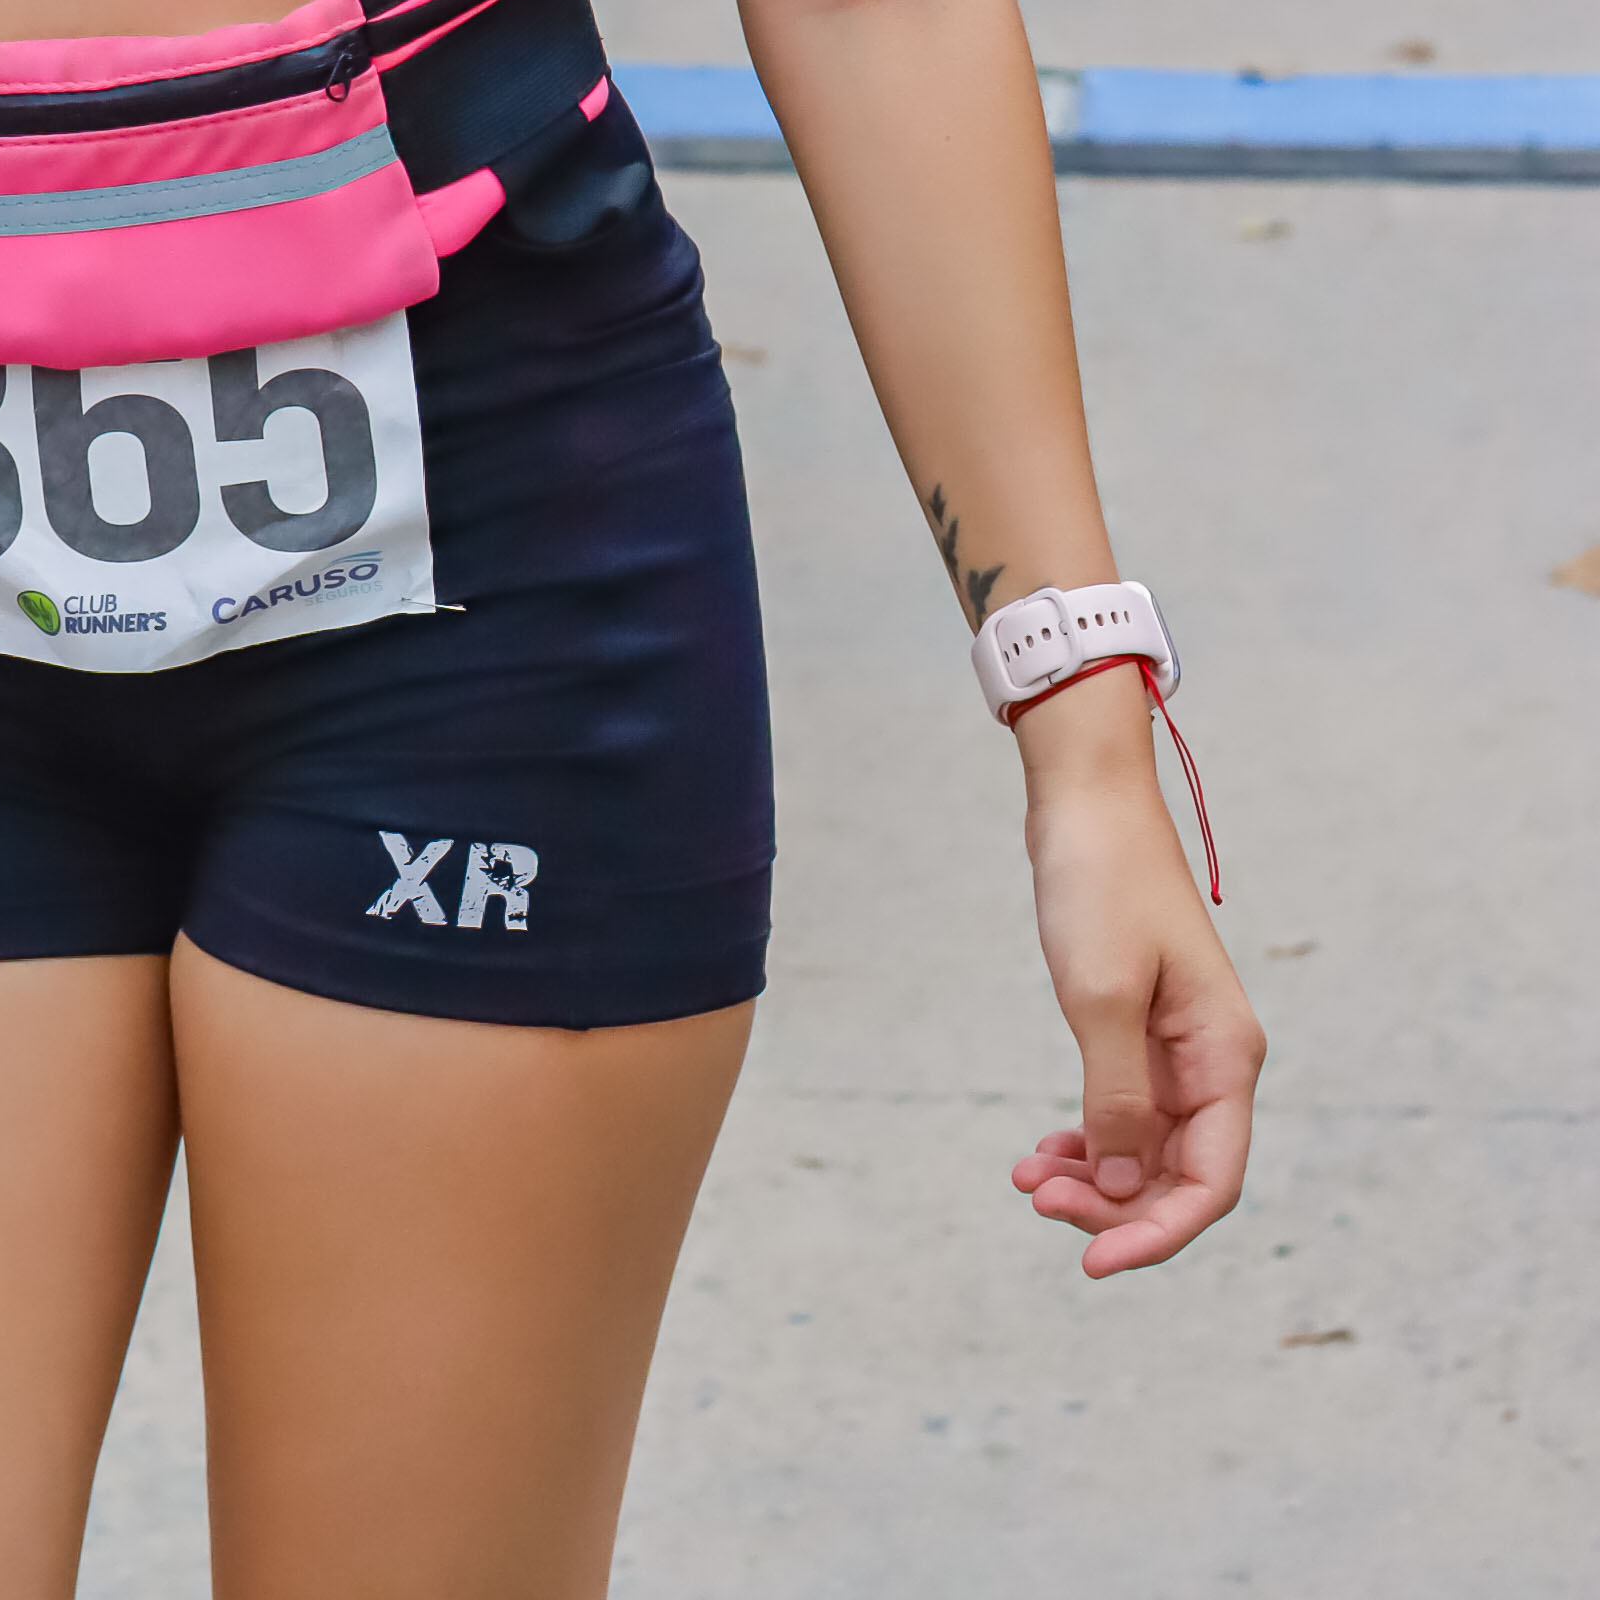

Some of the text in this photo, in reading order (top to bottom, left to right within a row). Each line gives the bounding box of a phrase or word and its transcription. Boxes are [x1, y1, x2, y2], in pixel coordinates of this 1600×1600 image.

[64, 593, 118, 615] CLUB
[211, 563, 379, 625] CARUSO
[304, 580, 384, 607] SEGUROS
[64, 611, 167, 634] RUNNER'S
[365, 830, 539, 931] XR
